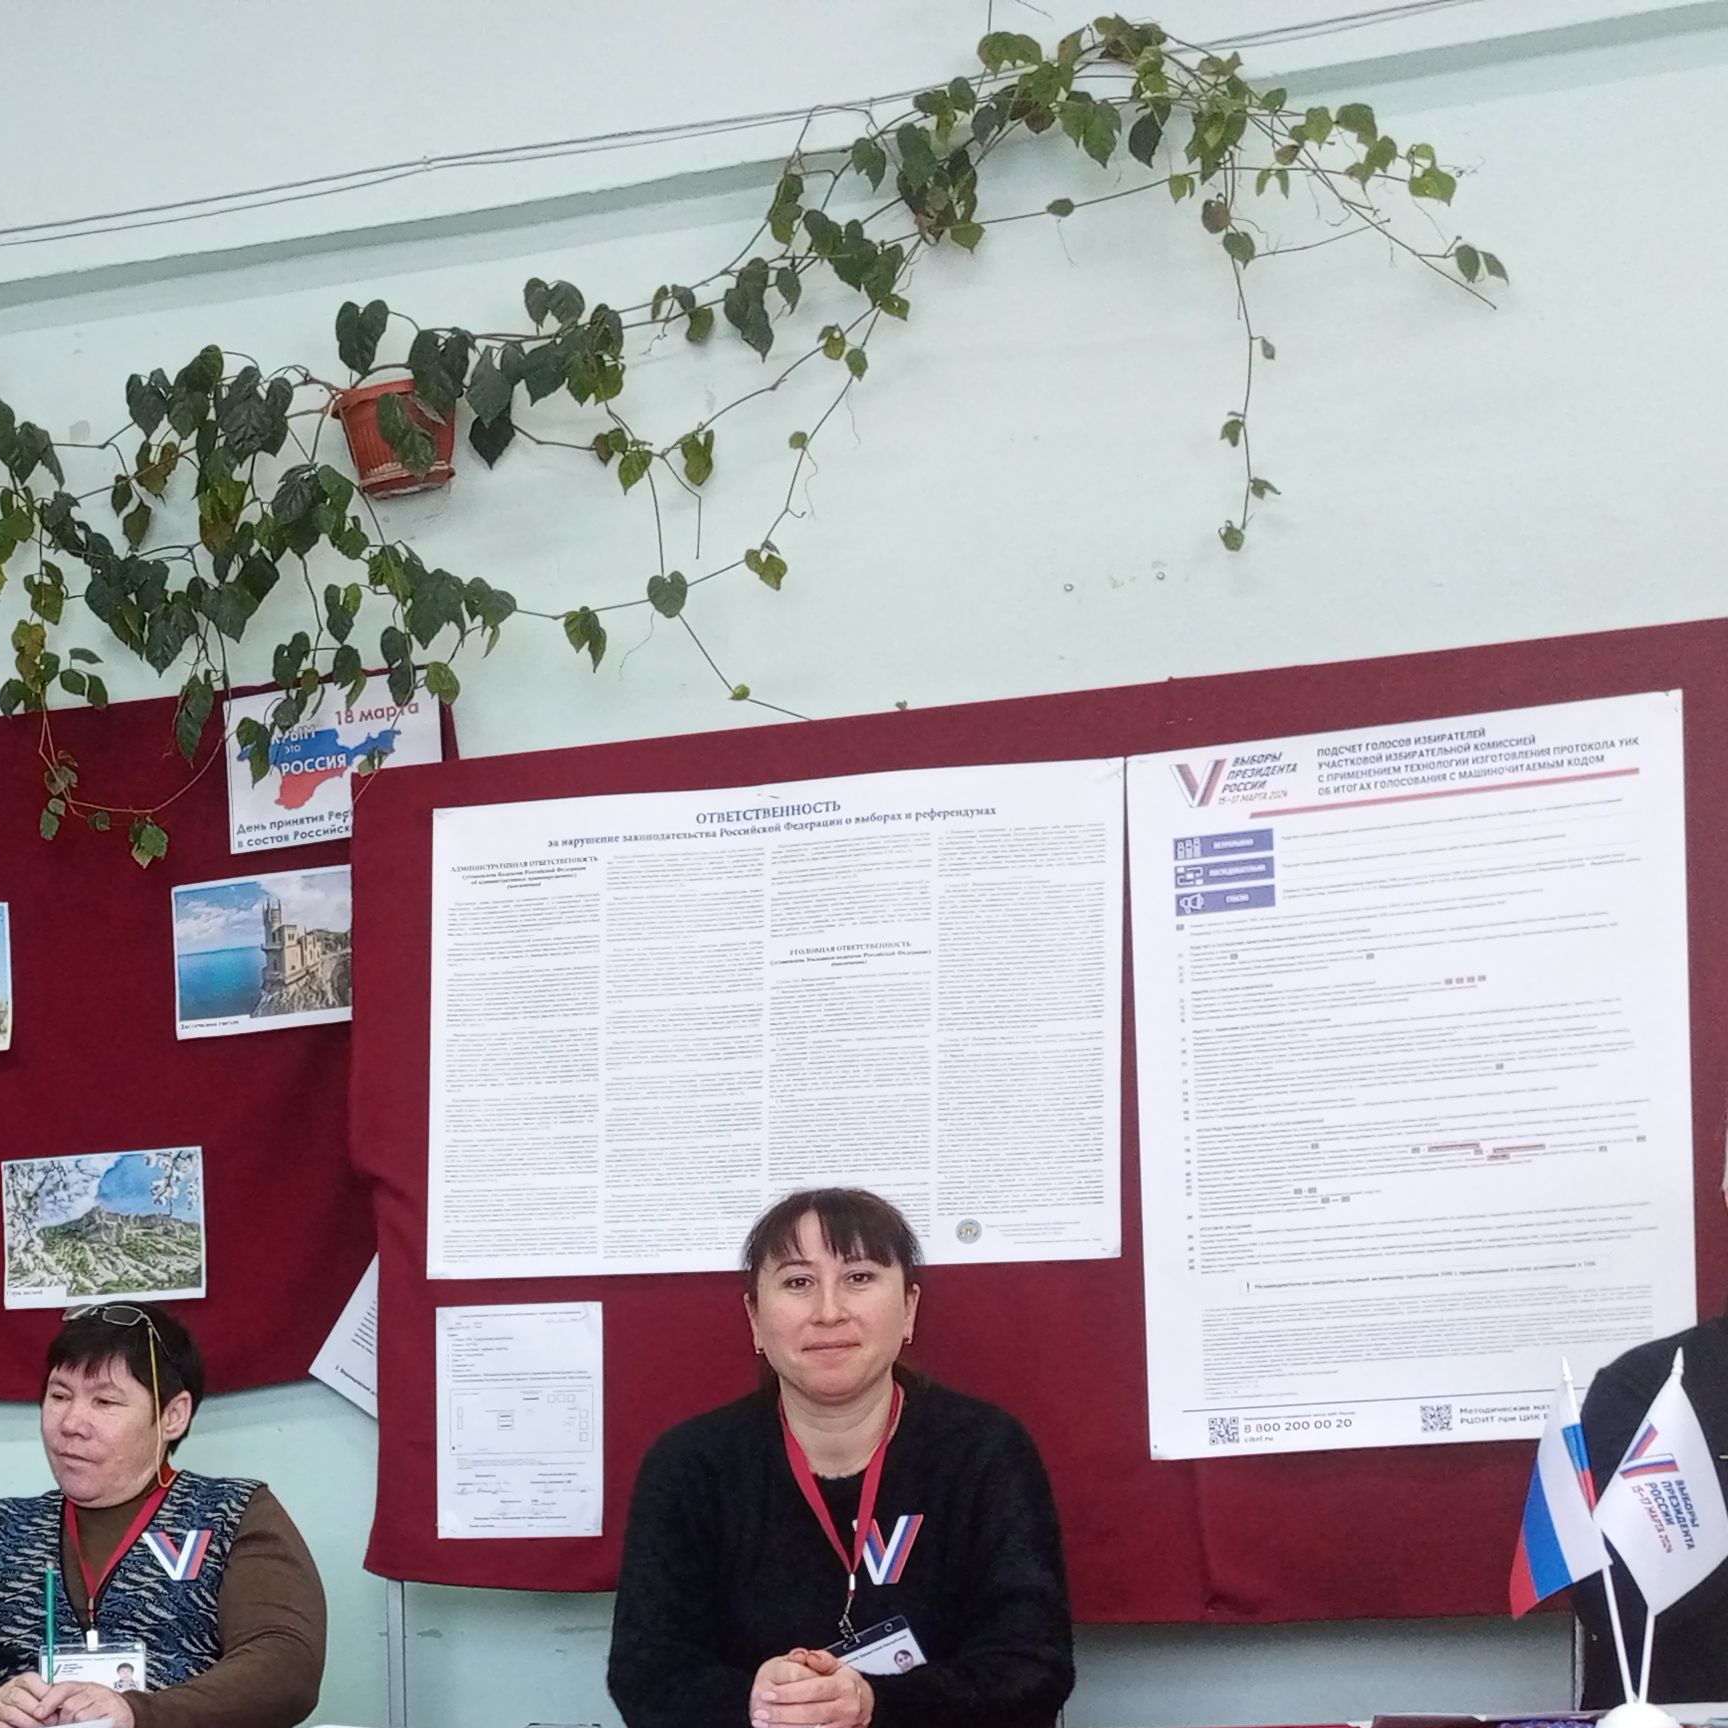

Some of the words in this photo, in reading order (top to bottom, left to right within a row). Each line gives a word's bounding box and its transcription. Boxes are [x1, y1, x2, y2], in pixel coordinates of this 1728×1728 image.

[335, 709, 355, 726] 18
[1317, 743, 1363, 757] ПОДСЧЕТ
[1365, 738, 1412, 752] ГОЛОСОВ
[1414, 728, 1486, 746] ИЗБИРАТЕЛЕЙ
[1318, 753, 1383, 770] УЧАСТКОВОЙ
[1385, 742, 1471, 762] ИЗБИРАТЕЛЬНОЙ
[1473, 734, 1536, 752] КОМИССИЕЙ
[280, 753, 347, 776] РОССИЯ
[1226, 763, 1298, 780] ПРЕЗИДЕНТА
[1231, 751, 1283, 767] ВЫБОРЫ
[1318, 774, 1325, 783] С
[1327, 765, 1402, 782] ПРИМЕНЕНИЕМ
[1404, 757, 1470, 774] ТЕХНОЛОГИИ
[1472, 748, 1551, 766] ИЗГОТОВЛЕНИЯ
[1553, 740, 1616, 756] ПРОТОКОЛА
[1618, 736, 1640, 748] УИК
[1221, 780, 1268, 793] РОССИИ
[1318, 786, 1331, 796] ОБ
[1333, 781, 1372, 794] ИТОГАХ
[1374, 773, 1447, 791] ГОЛОСОВАНИЯ
[1449, 772, 1456, 781] С
[1458, 759, 1565, 779] МАШИНОЧИТАЕМЫМ
[1567, 754, 1605, 767] КОДОМ
[236, 824, 267, 835] День
[269, 814, 324, 830] принятия
[696, 801, 841, 825] ОТВЕТСТВЕННОСТЬ
[548, 840, 559, 848] за
[561, 834, 620, 847] нарушение
[622, 829, 717, 843] законодательства
[719, 822, 781, 838] Российской
[784, 817, 843, 831] Федерации
[855, 811, 902, 824] выборах
[914, 806, 997, 820] референдумах
[1244, 1424, 1252, 1433] 8
[1255, 1423, 1281, 1432] 800
[1285, 1421, 1310, 1431] 200
[1314, 1420, 1332, 1429] 00
[1336, 1418, 1353, 1428] 20
[1645, 1482, 1675, 1525] РОССИИ
[1660, 1481, 1696, 1550] ПРЕЗИДЕНТА
[1674, 1480, 1700, 1528] ВЫБОРЫ
